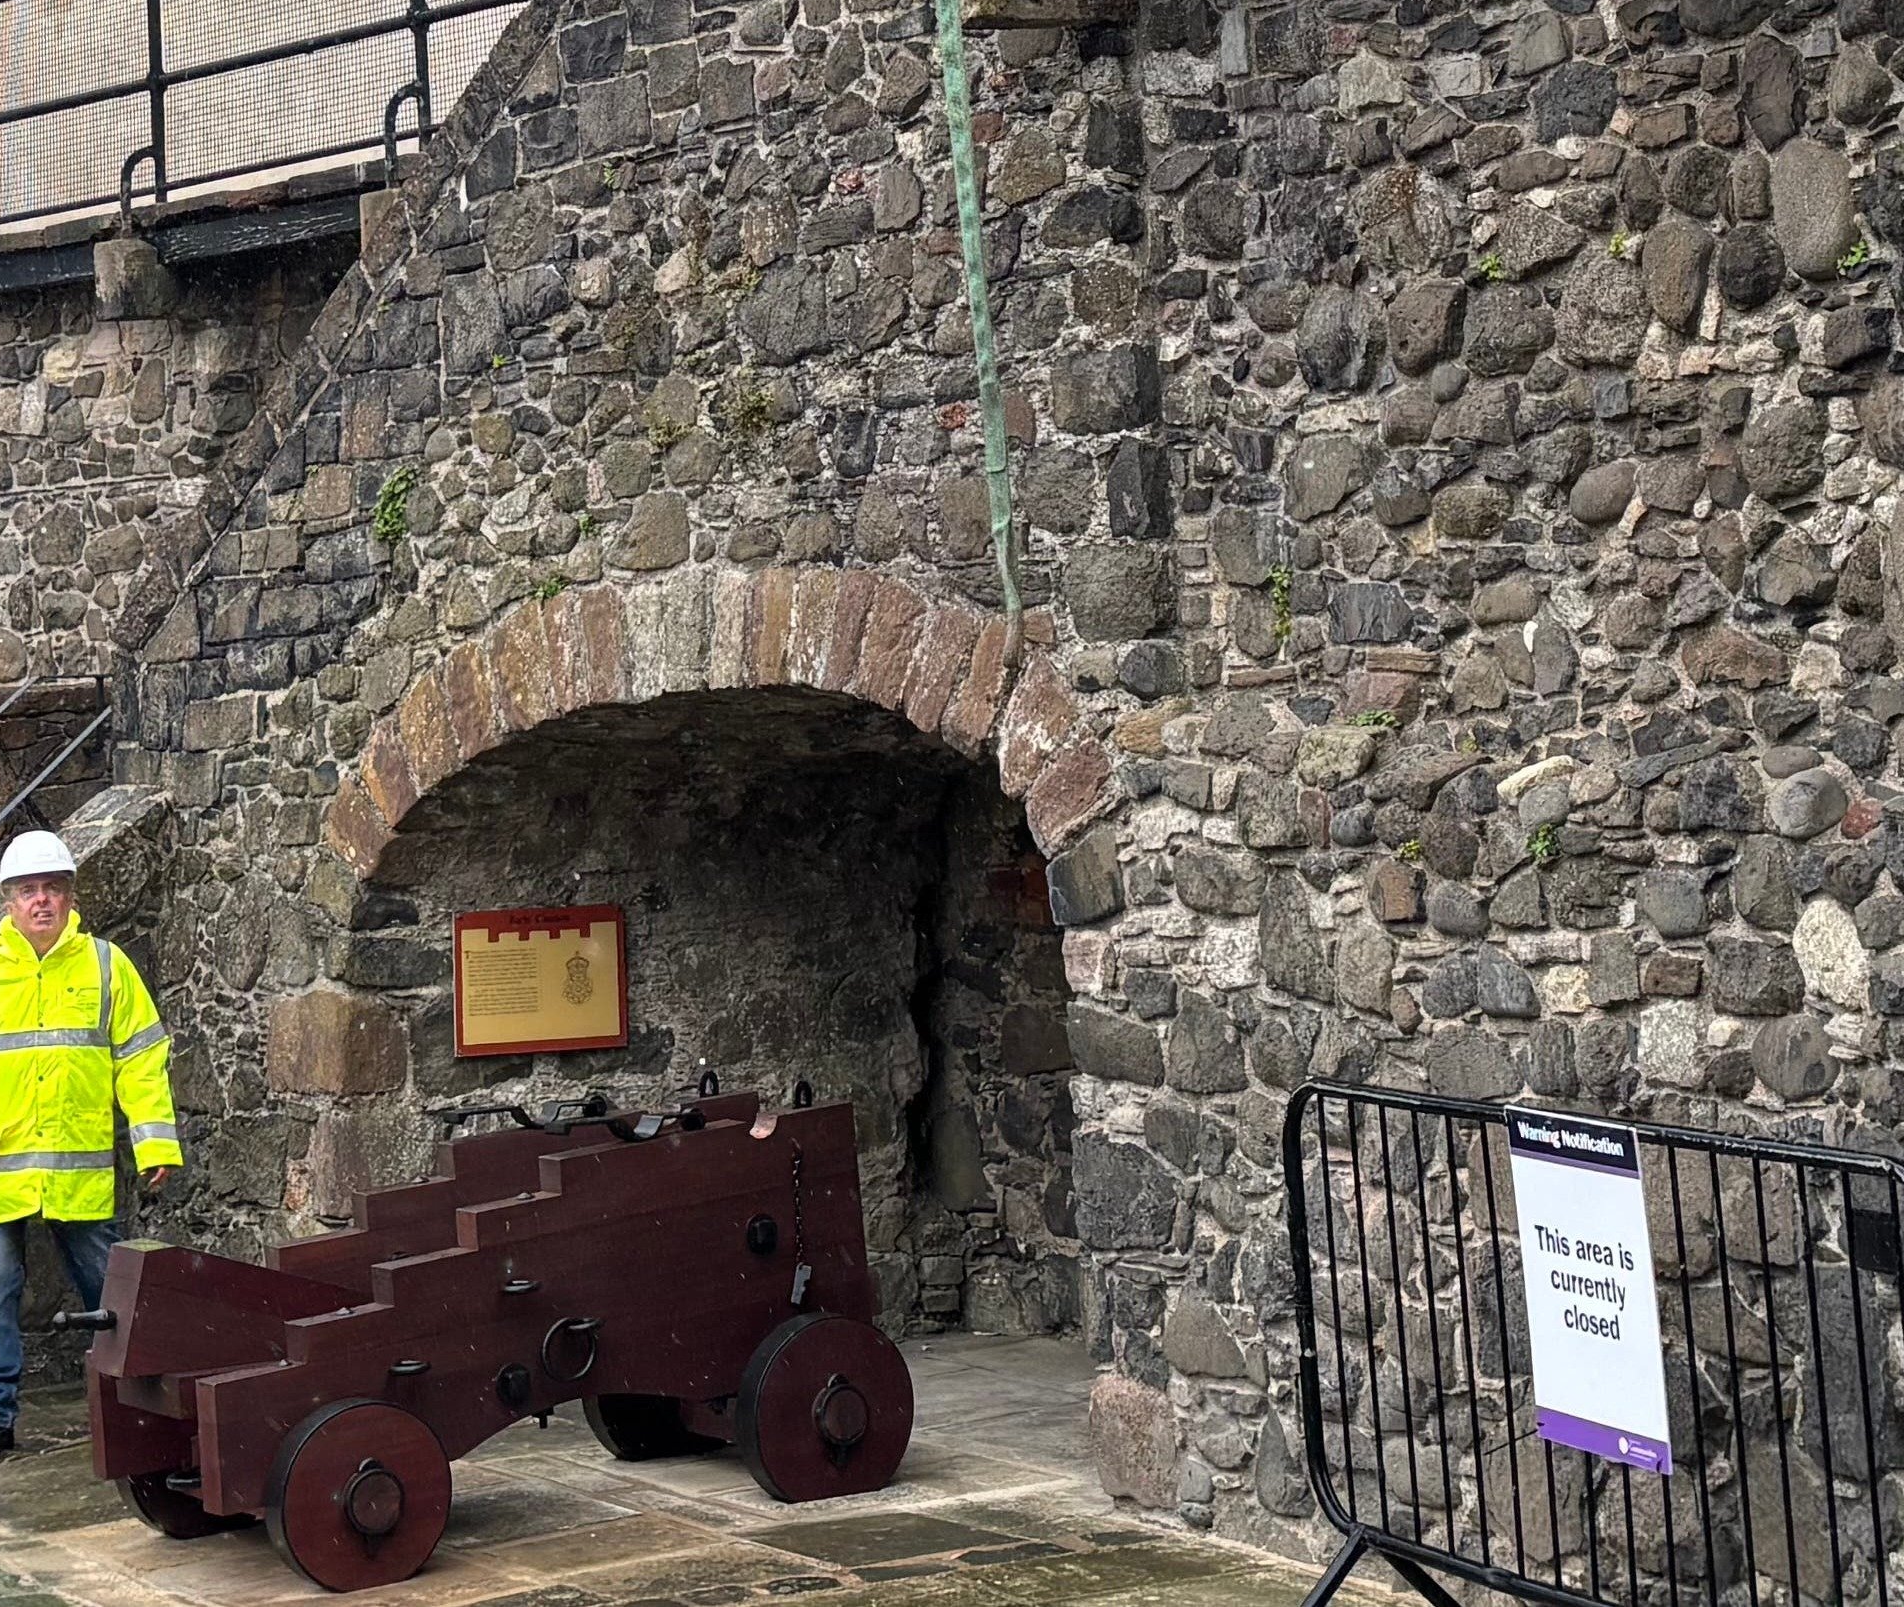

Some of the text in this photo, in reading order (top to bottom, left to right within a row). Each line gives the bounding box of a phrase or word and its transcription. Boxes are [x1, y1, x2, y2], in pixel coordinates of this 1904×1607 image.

[1517, 1120, 1625, 1157] Warning Notification
[1534, 1224, 1634, 1271] This area is
[1551, 1269, 1626, 1311] currently
[1564, 1304, 1620, 1341] closed
